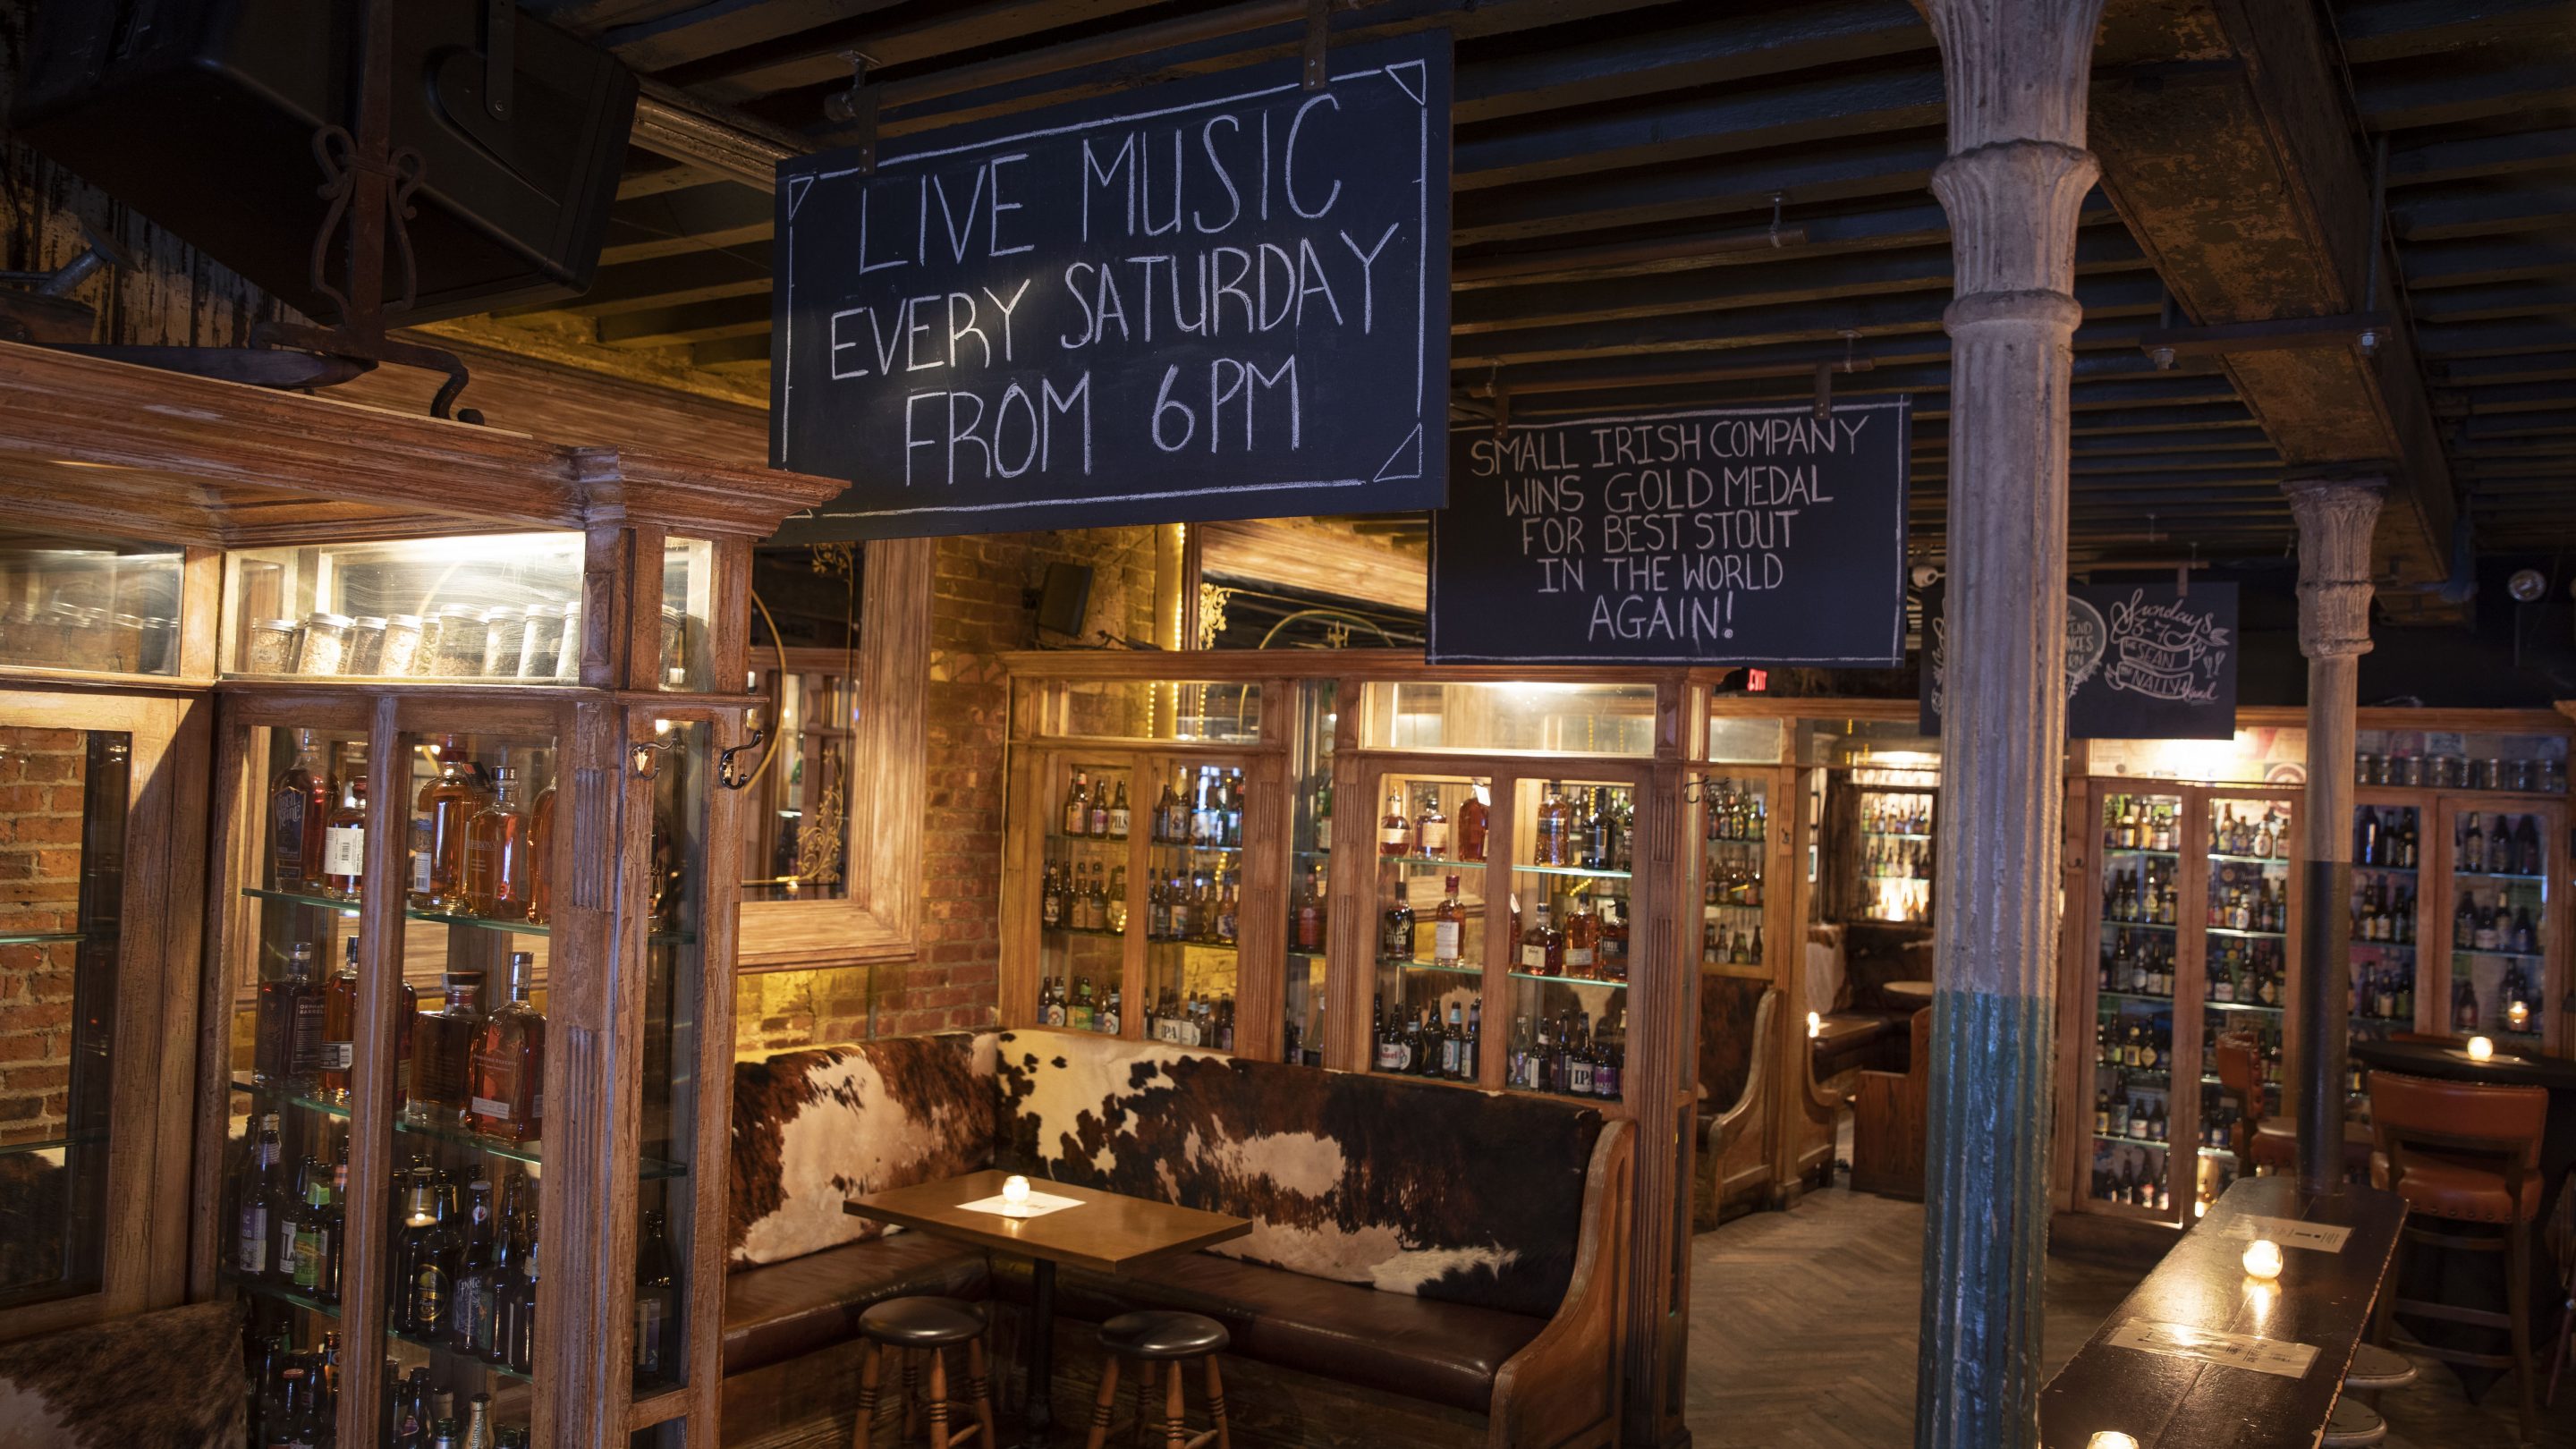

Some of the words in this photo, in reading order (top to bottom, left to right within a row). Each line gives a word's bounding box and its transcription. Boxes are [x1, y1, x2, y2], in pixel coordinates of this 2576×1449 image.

[860, 153, 1035, 275] LIVE
[1083, 94, 1341, 242] MUSIC
[832, 279, 1031, 380] EVERY
[1062, 224, 1399, 349] SATURDAY
[905, 370, 1091, 486] FROM
[1470, 432, 1579, 476] SMALL
[1591, 424, 1700, 469] IRISH
[1710, 416, 1868, 458] COMPANY
[1504, 475, 1584, 516] WINS
[1605, 468, 1713, 513] GOLD
[1724, 465, 1834, 507] MEDAL
[1522, 516, 1585, 555] FOR
[1604, 513, 1683, 553] BEST
[1695, 510, 1800, 550] STOUT
[1538, 558, 1585, 593] IN
[1603, 555, 1671, 591] THE
[1682, 554, 1784, 591] WORLD
[1589, 591, 1733, 641] AGAIN!
[2138, 643, 2174, 668] SEAN
